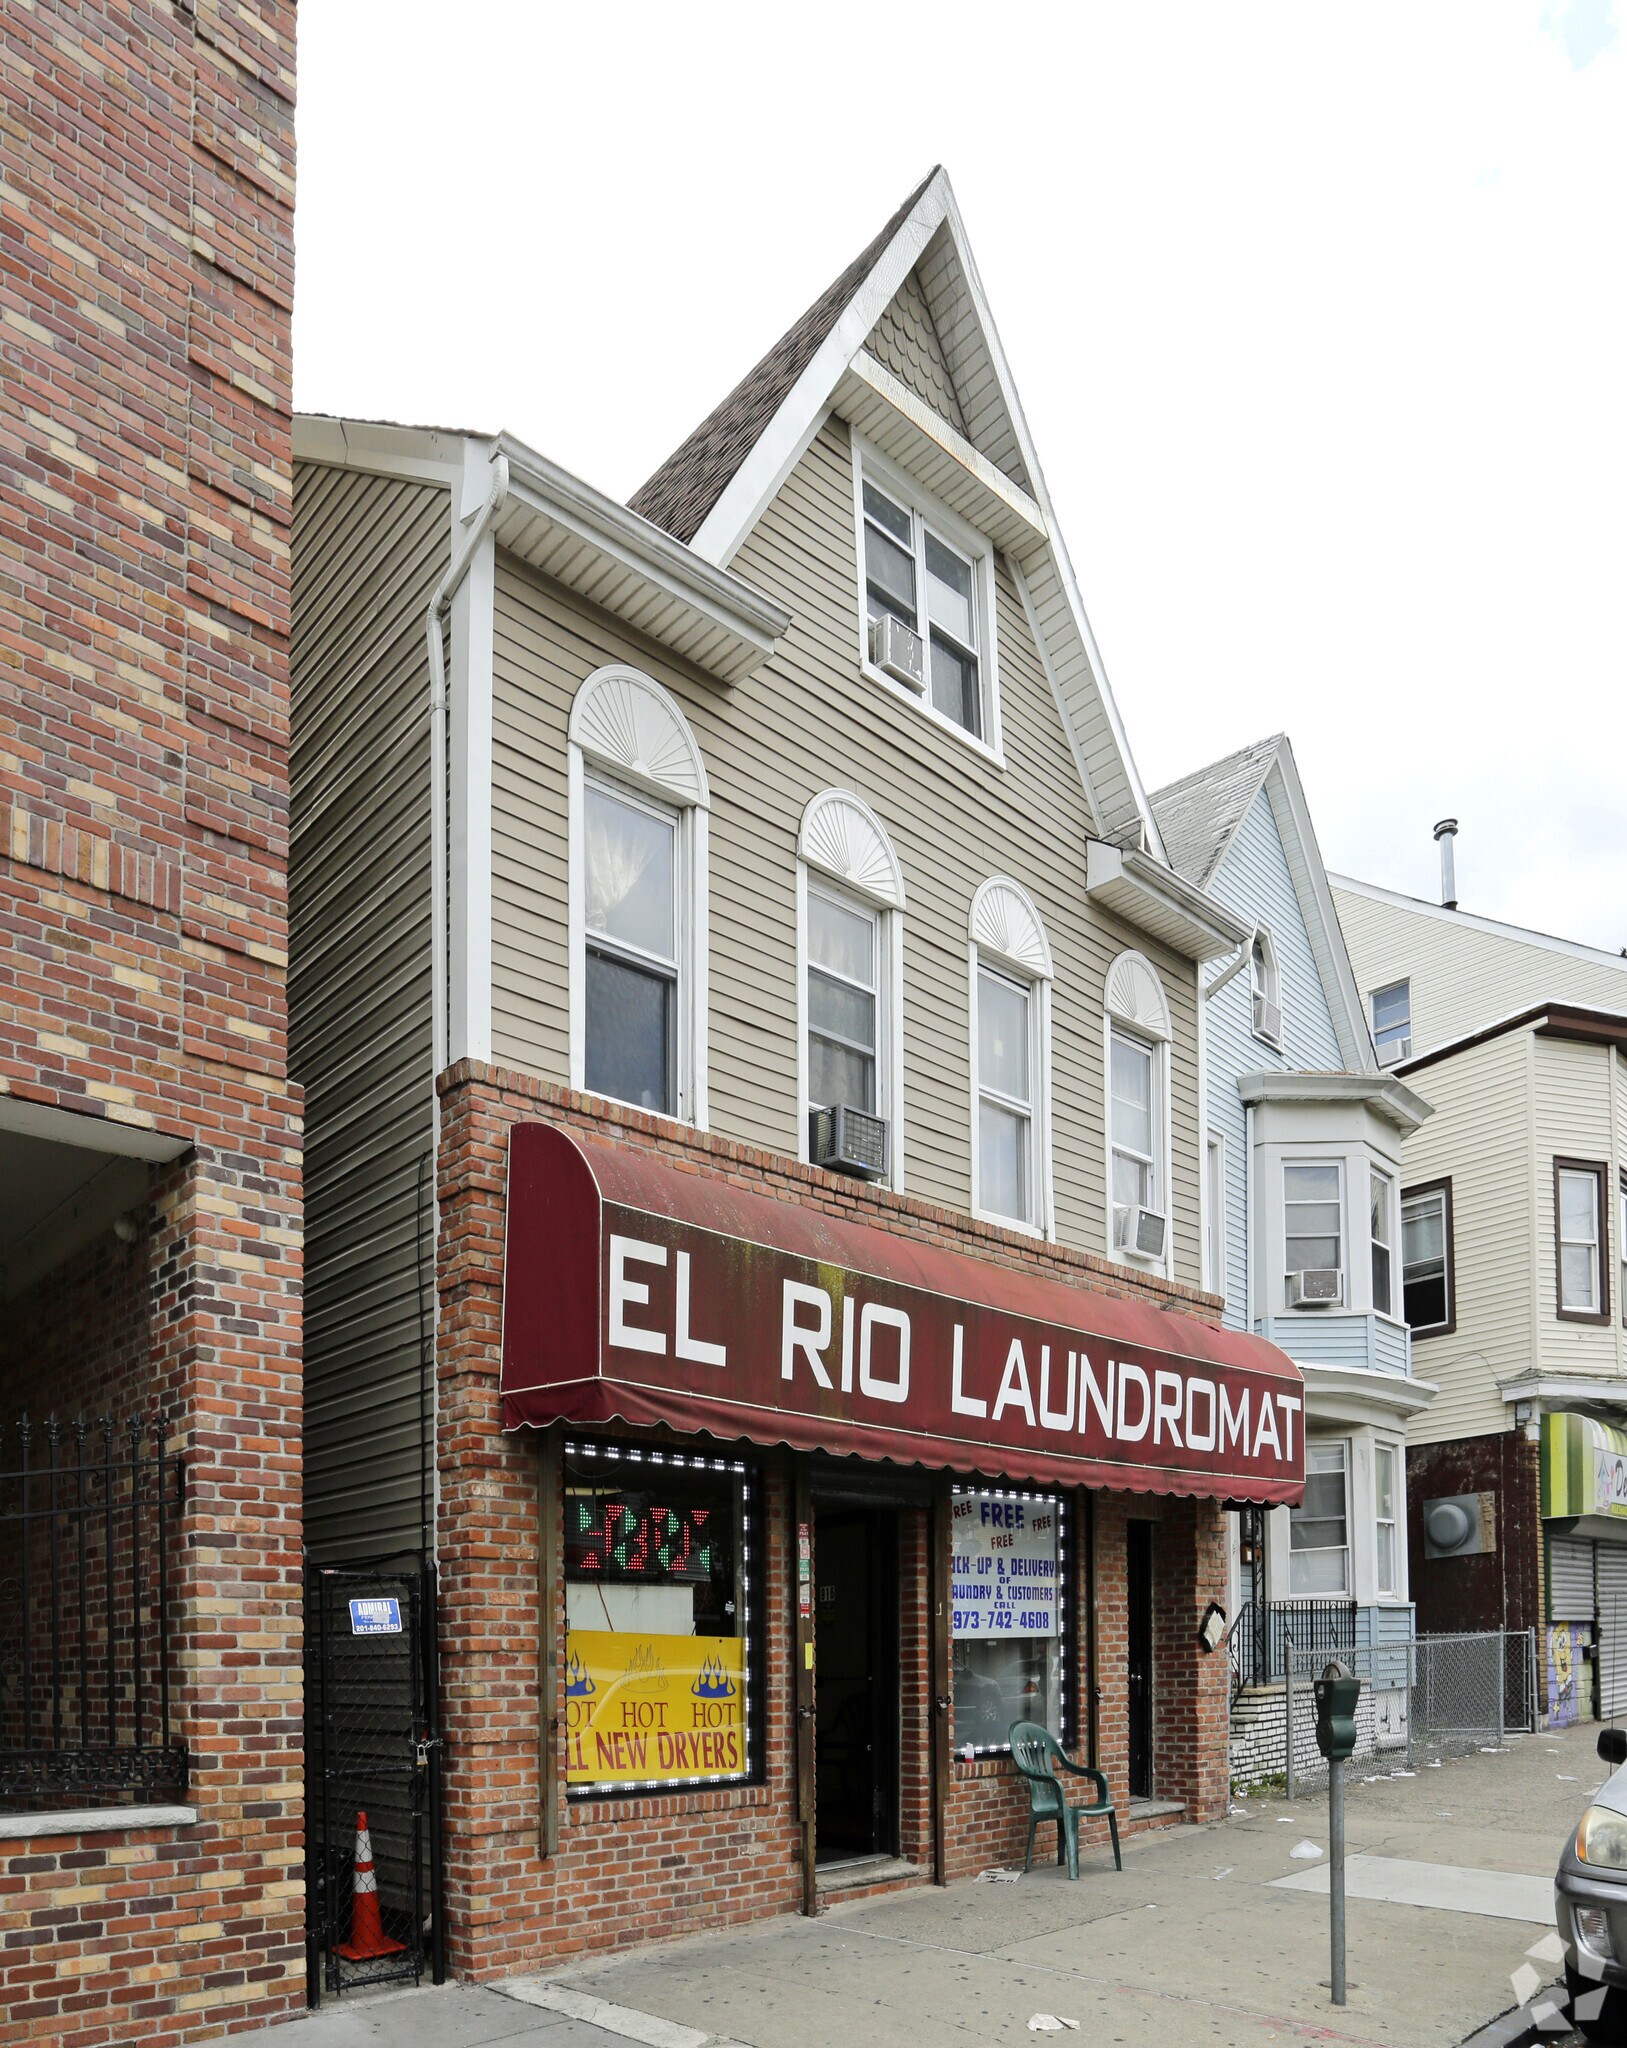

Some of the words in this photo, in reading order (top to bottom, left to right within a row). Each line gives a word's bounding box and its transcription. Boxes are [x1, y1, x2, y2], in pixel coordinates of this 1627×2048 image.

[609, 1234, 727, 1367] EL
[781, 1279, 911, 1404] RIO
[951, 1324, 1302, 1462] LAUNDROMAT
[952, 1501, 973, 1519] REE
[980, 1502, 1025, 1530] FREE
[1032, 1515, 1052, 1532] FREE
[990, 1533, 1014, 1550] FREE
[997, 1557, 1006, 1576] &
[1011, 1558, 1055, 1577] DELIVERY
[999, 1576, 1011, 1584] OF
[996, 1585, 1003, 1600] &
[1007, 1586, 1053, 1601] CUSTOMERS
[357, 1601, 393, 1616] ADMIRAL
[994, 1601, 1016, 1610] CALL
[953, 1611, 1049, 1629] 973-742-4608
[620, 1701, 669, 1728] HOT
[691, 1702, 737, 1728] HOT
[595, 1731, 648, 1770] NEW
[657, 1731, 738, 1769] DRYERS
